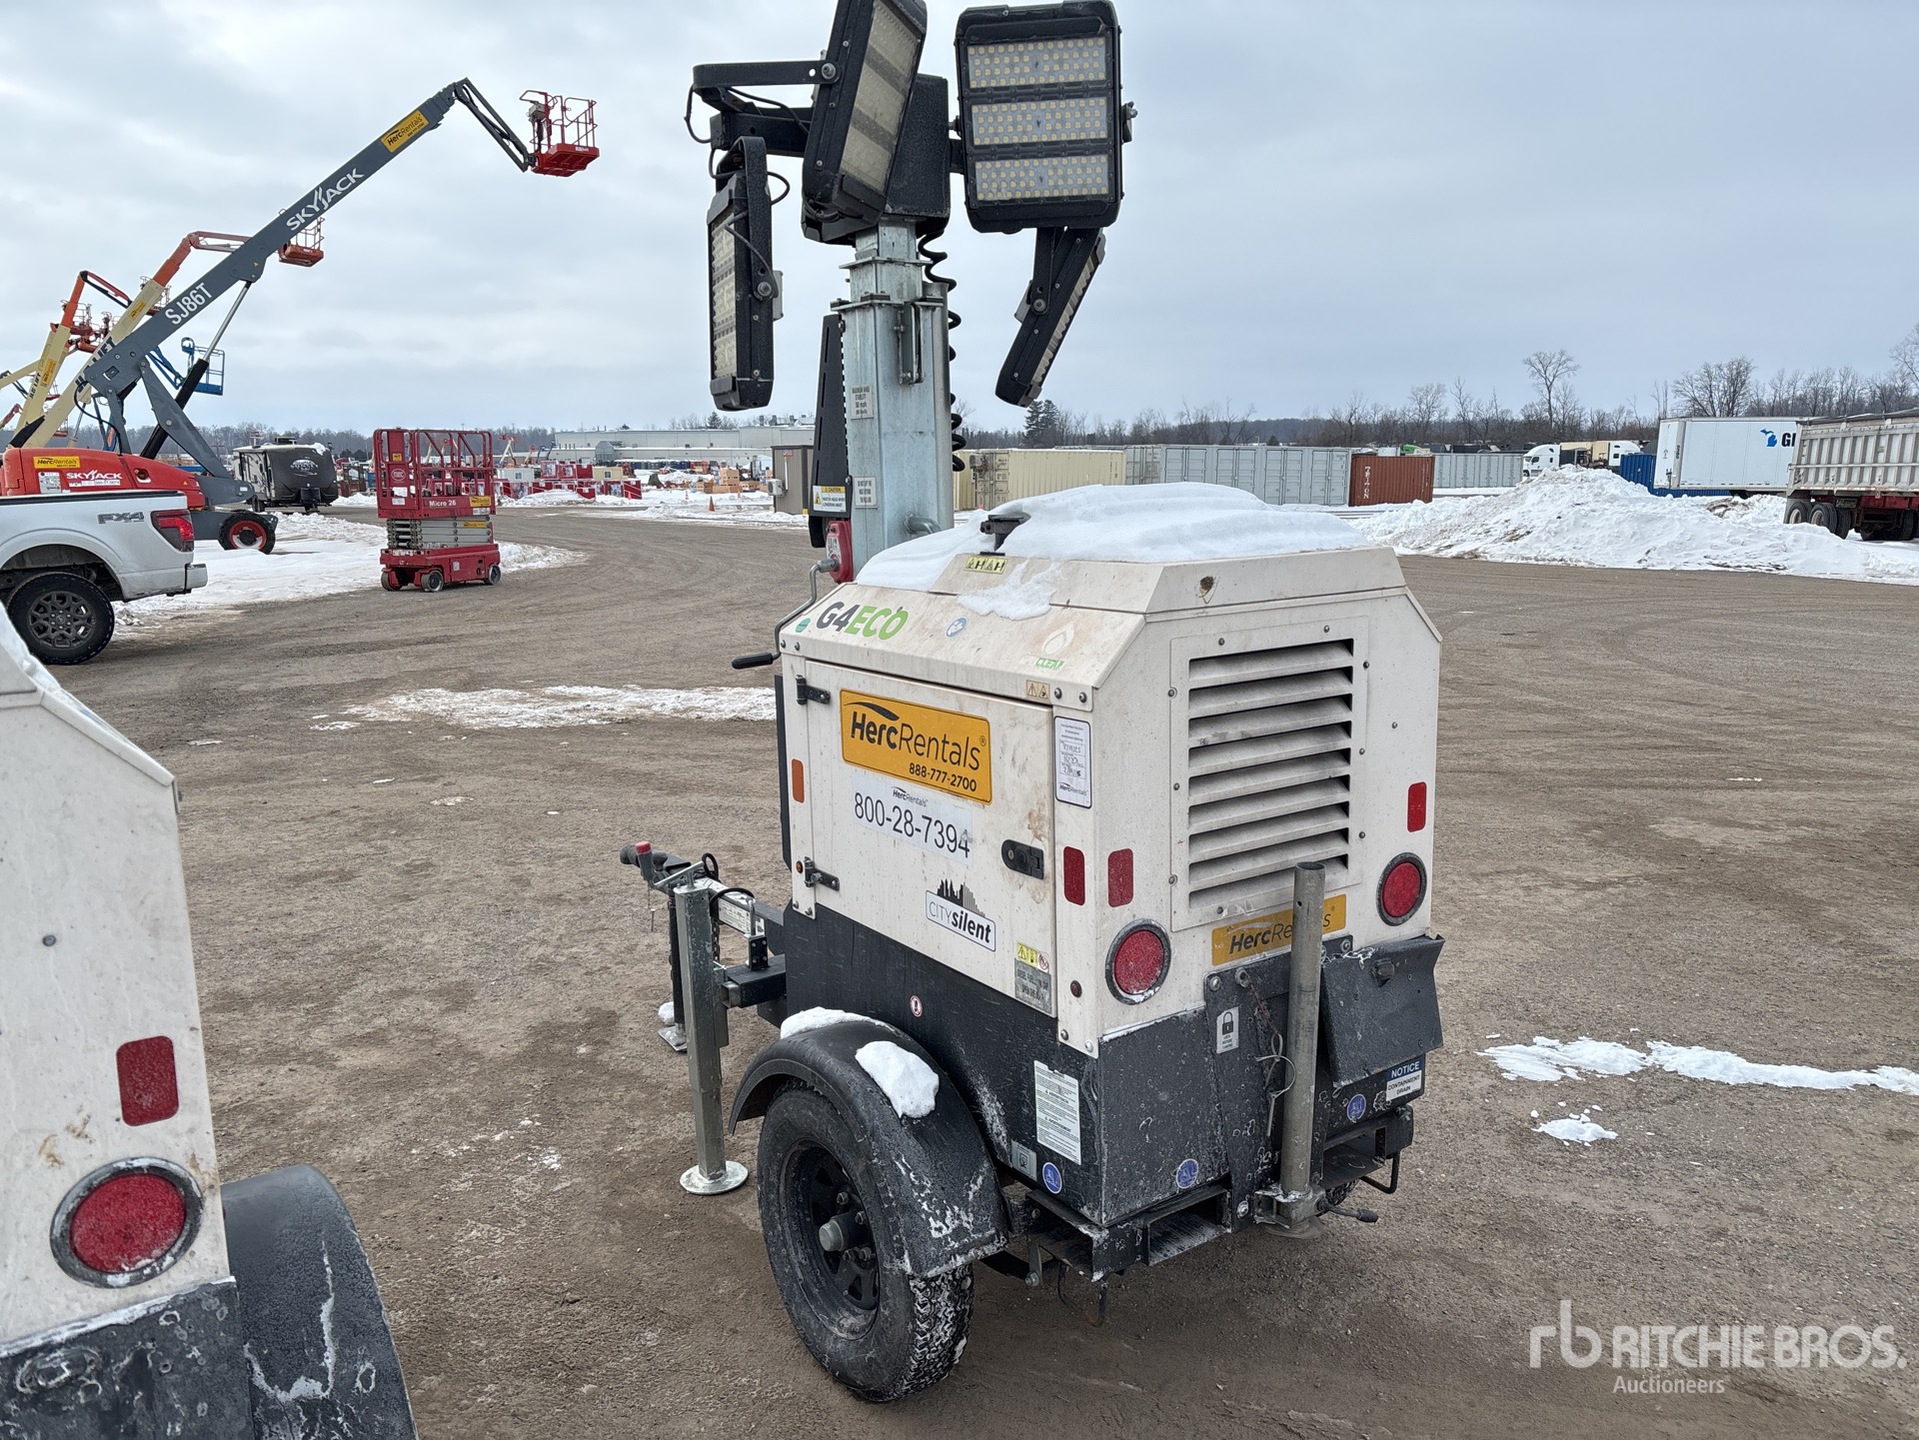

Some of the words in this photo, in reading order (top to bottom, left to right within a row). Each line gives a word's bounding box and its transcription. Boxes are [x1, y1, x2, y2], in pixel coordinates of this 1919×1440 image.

[387, 115, 423, 146] HercRentals
[286, 167, 365, 231] SKYJACK
[164, 282, 212, 325] SJ86T
[66, 469, 123, 480] SKYJACK
[429, 500, 447, 508] Micro
[448, 499, 457, 507] 26
[97, 511, 145, 524] FX4
[816, 601, 909, 640] G4ECO
[850, 711, 981, 771] HercRentals
[908, 762, 977, 792] 888-777-2700
[892, 789, 927, 807] HercRentals
[854, 792, 971, 858] 800-28-7394
[1391, 1060, 1420, 1078] NOTICE
[1387, 1074, 1420, 1091] CONTAINMENT
[1396, 1085, 1411, 1095] DRAIN
